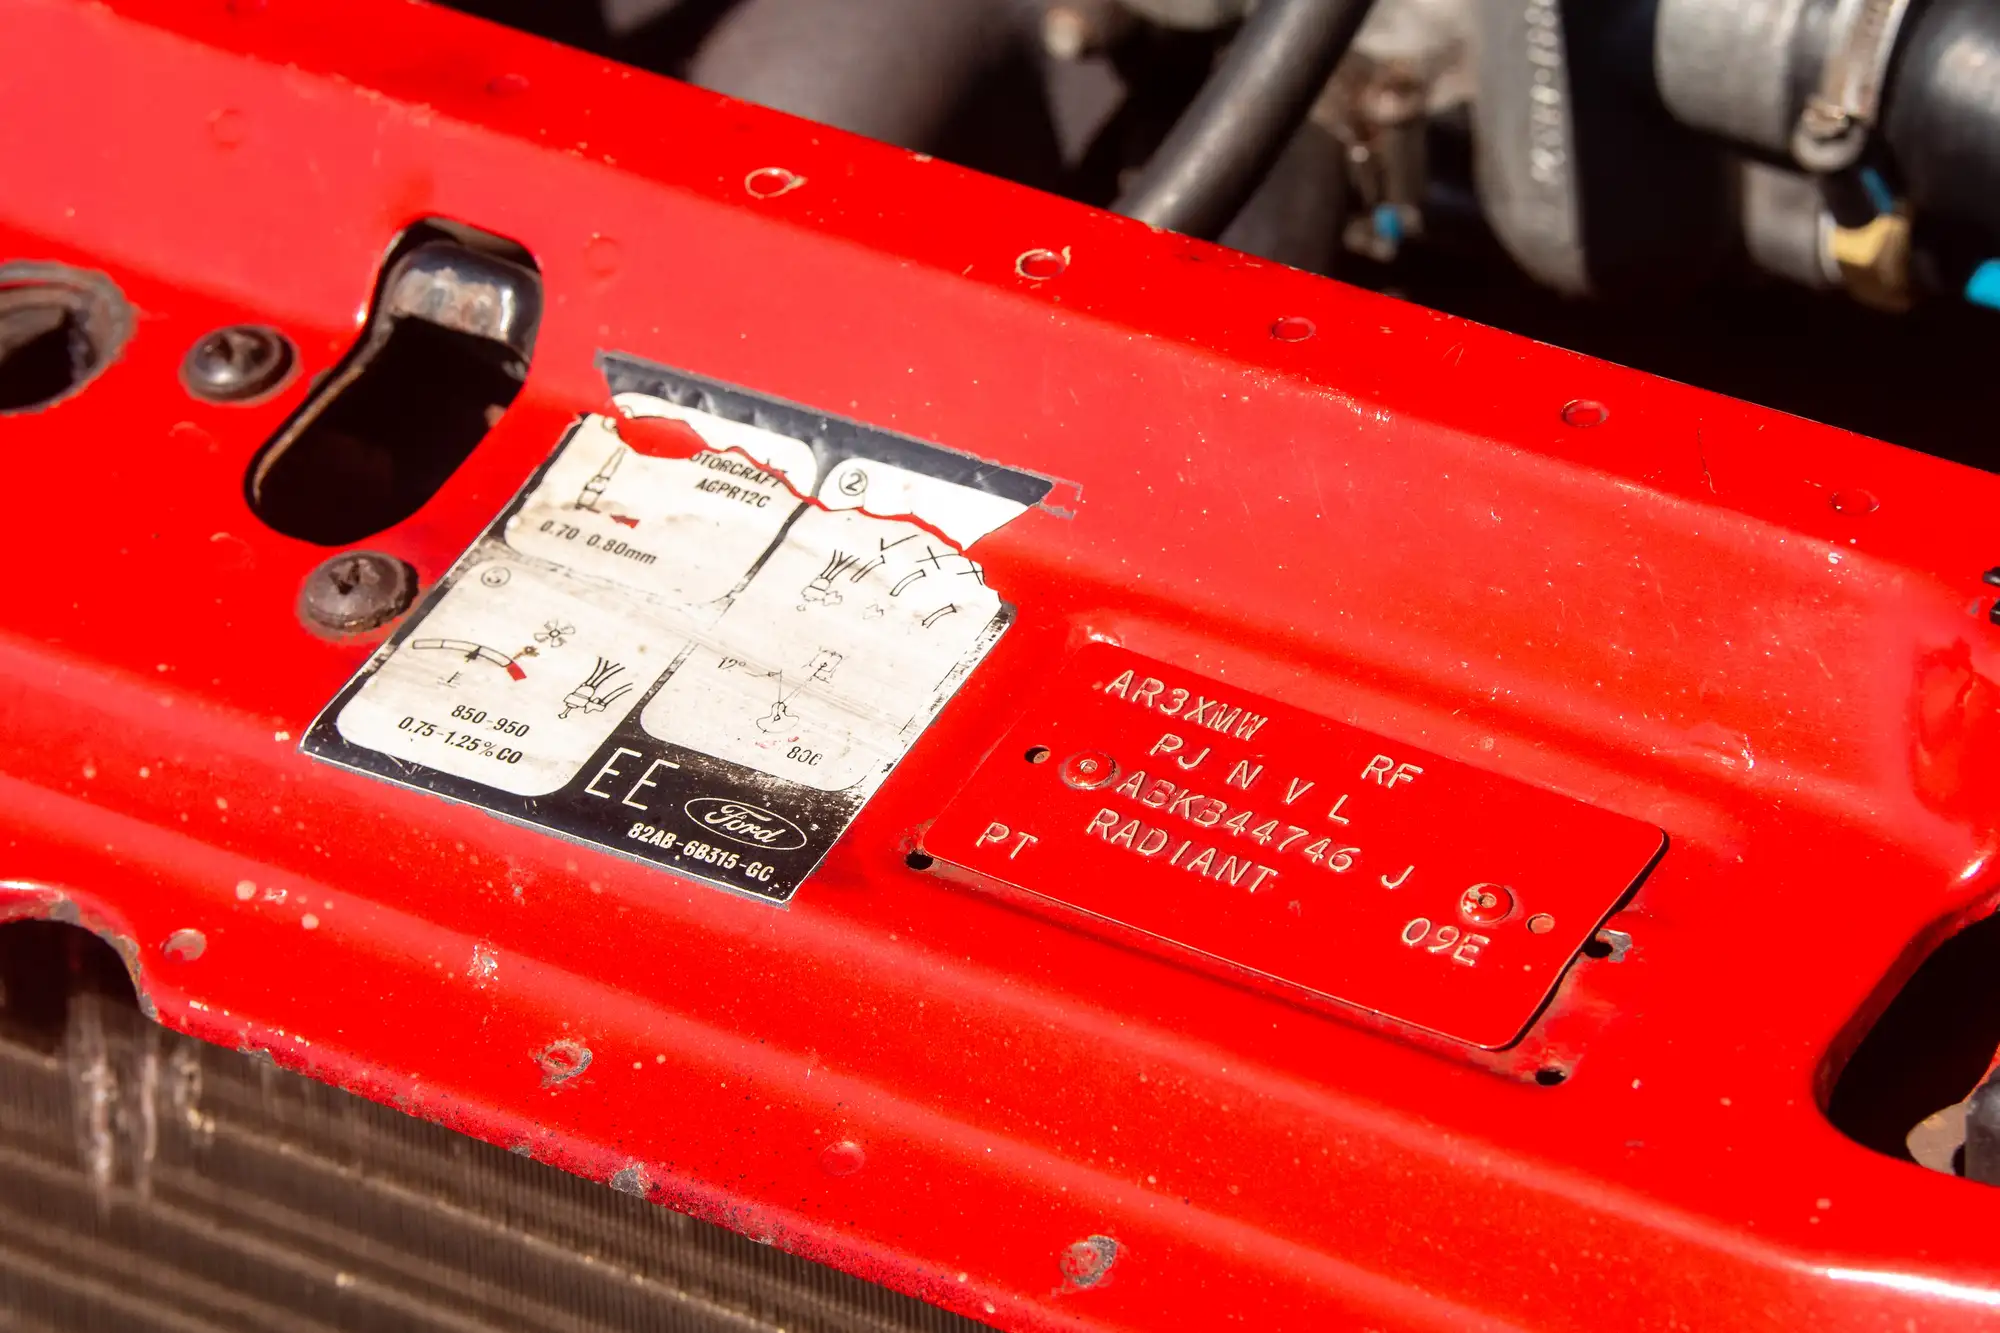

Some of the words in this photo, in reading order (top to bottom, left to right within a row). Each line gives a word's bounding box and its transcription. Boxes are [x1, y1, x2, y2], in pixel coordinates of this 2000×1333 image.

[694, 478, 771, 508] AGPR12C
[451, 704, 530, 738] 850-950
[1105, 669, 1268, 741] AR3XMW
[1150, 732, 1211, 770] PJ
[1226, 760, 1263, 790] N
[1285, 777, 1315, 805] V
[1328, 794, 1350, 824] L
[1361, 754, 1423, 788] RF
[704, 803, 784, 844] Ford
[976, 822, 1039, 859] PT
[1116, 770, 1361, 872] ABKB44746
[1380, 865, 1415, 889] J
[627, 822, 775, 882] 82AB-6B315-GC
[1086, 807, 1279, 892] RADIANT
